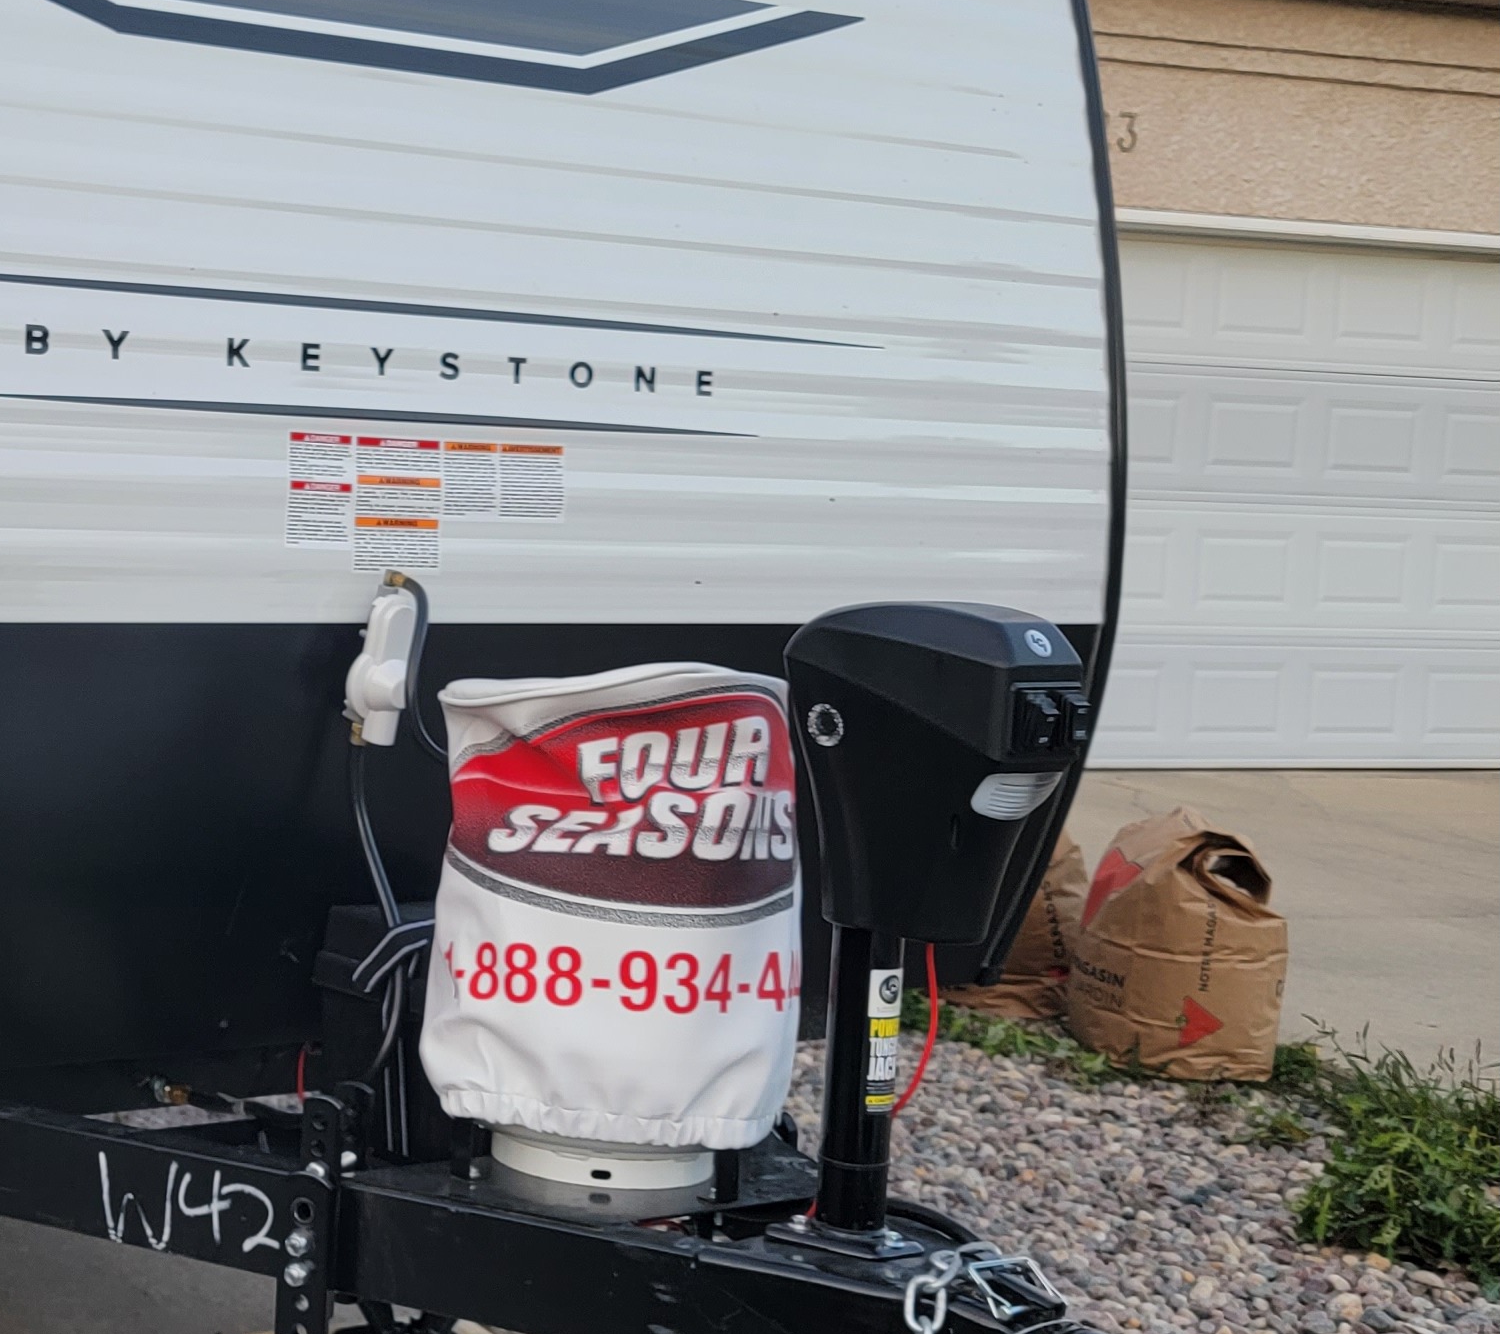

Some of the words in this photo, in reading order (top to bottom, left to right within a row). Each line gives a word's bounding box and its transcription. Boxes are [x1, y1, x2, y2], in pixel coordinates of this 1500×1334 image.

[24, 324, 130, 361] BY
[227, 338, 713, 397] KEYSTONE
[578, 716, 770, 805] FOUR
[488, 790, 795, 861] SEASONS
[867, 1056, 896, 1080] JAC
[99, 1151, 280, 1252] W42
